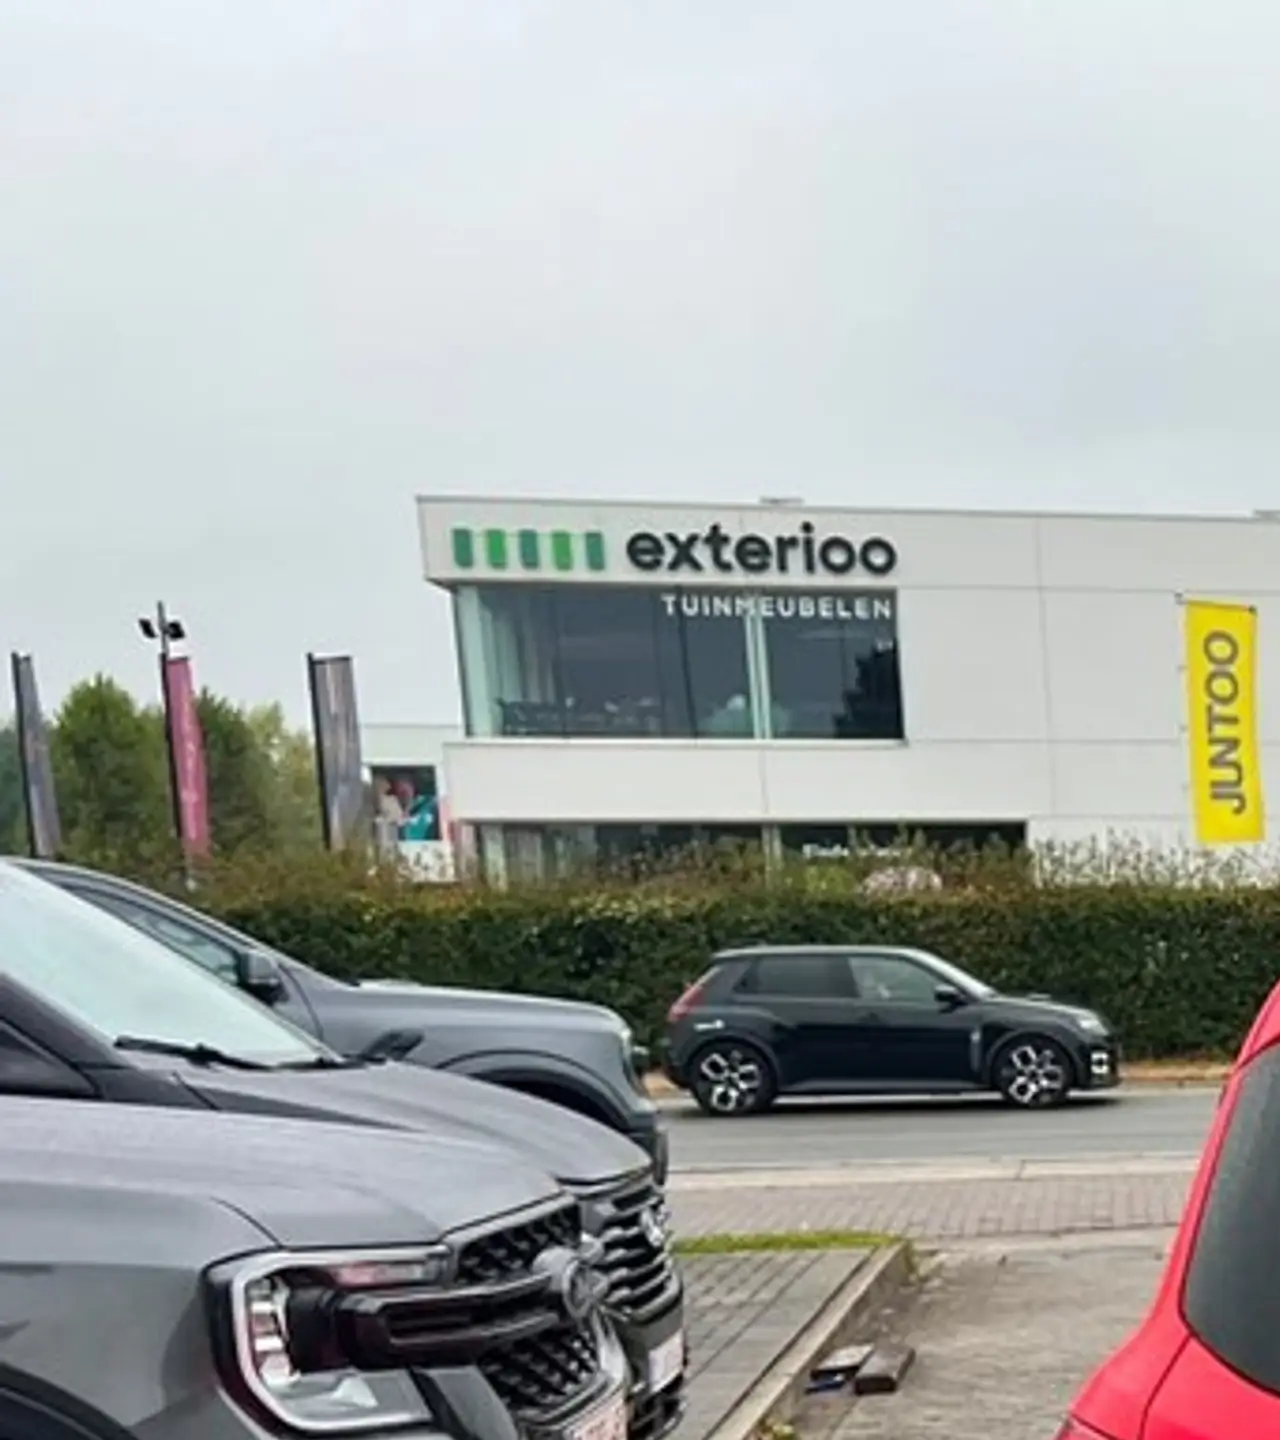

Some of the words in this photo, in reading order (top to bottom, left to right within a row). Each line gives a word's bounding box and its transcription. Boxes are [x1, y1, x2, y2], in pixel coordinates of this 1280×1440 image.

[625, 520, 898, 575] exterioo
[661, 594, 892, 619] TUINMEUBELEN
[1203, 630, 1247, 815] JUNTOO
